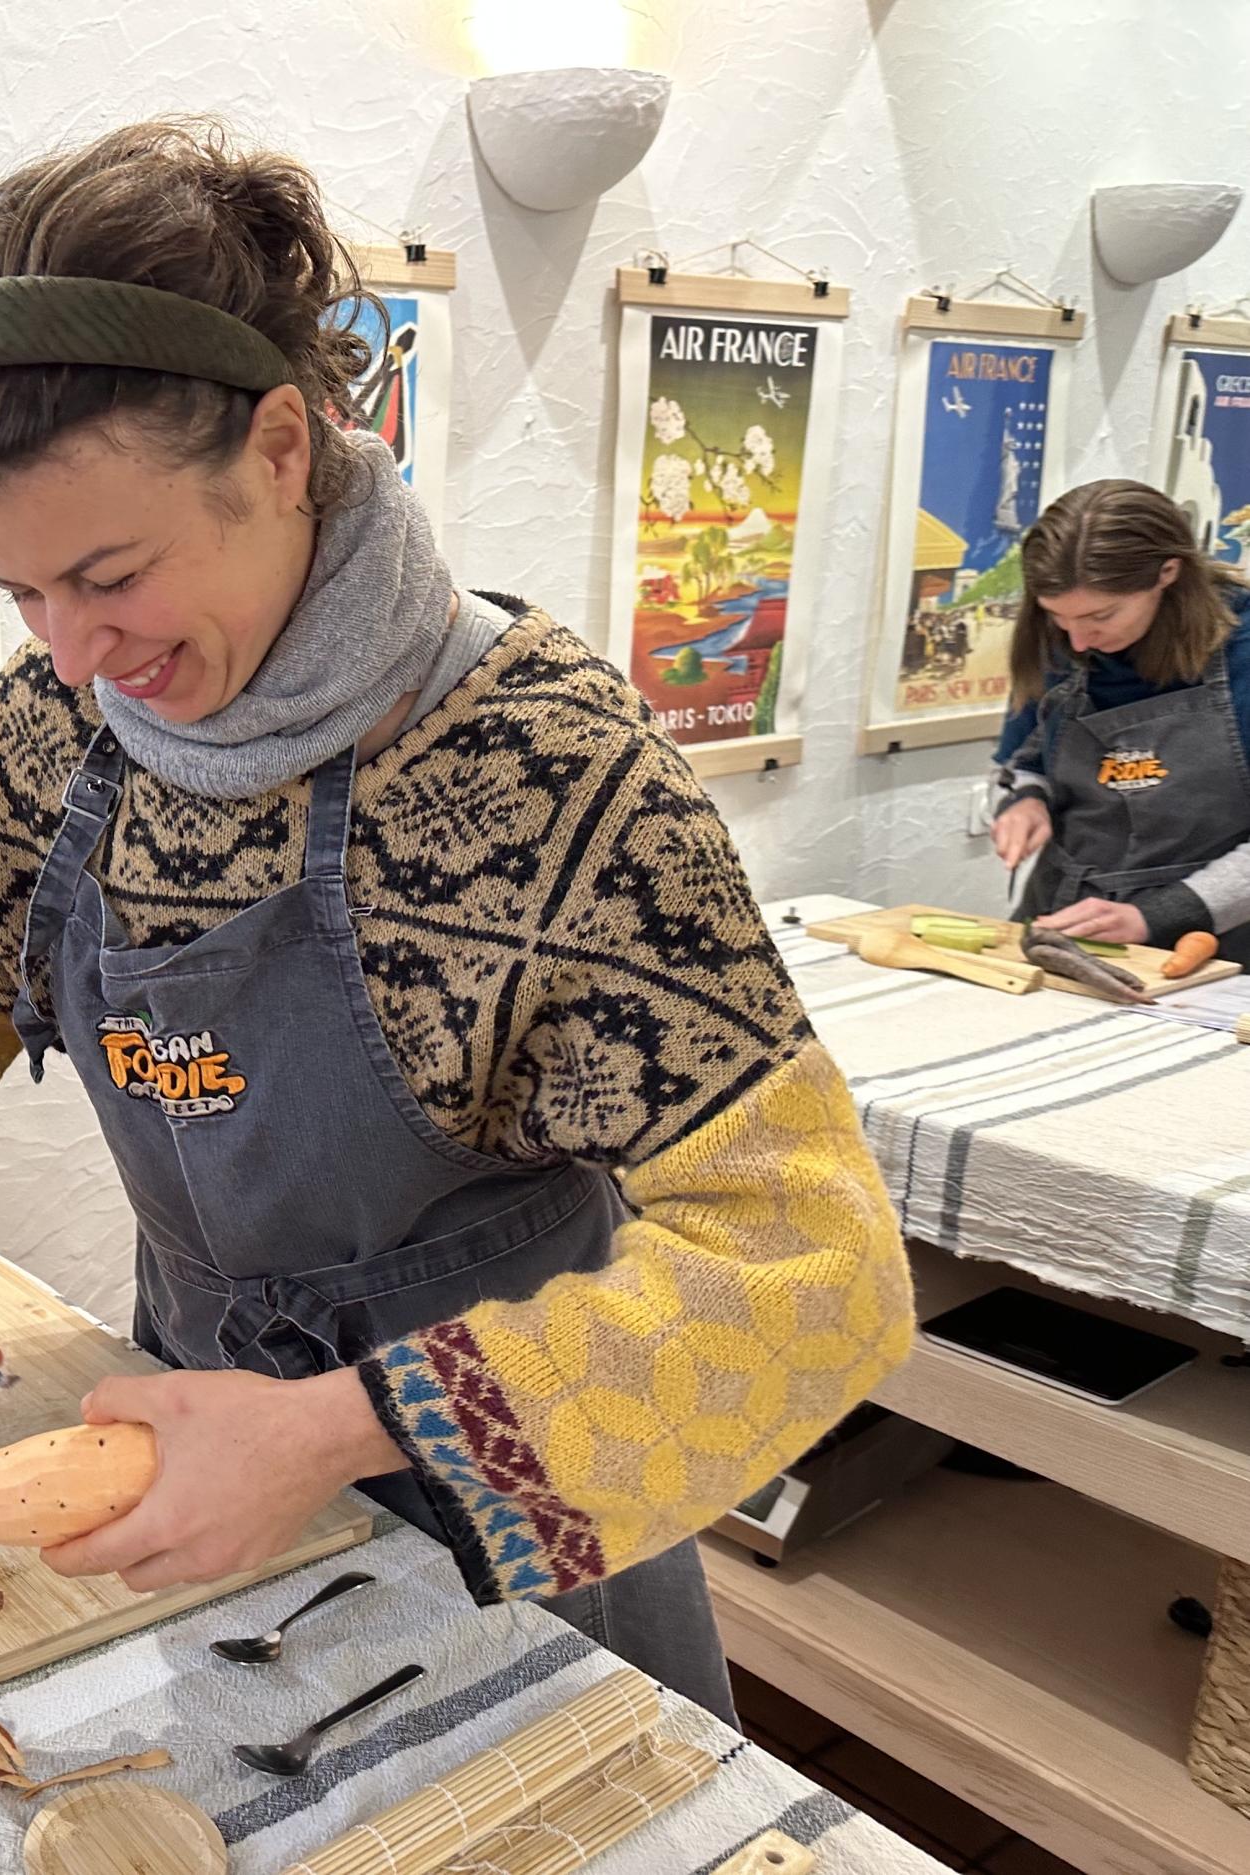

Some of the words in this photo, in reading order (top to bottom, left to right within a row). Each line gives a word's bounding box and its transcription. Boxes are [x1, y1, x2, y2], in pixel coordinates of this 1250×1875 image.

[660, 325, 705, 361] AIR
[709, 327, 810, 367] FRANCE
[946, 352, 977, 379] AIR
[979, 353, 1038, 382] FRANCE
[116, 1019, 135, 1028] THE
[149, 1086, 212, 1114] PJECT
